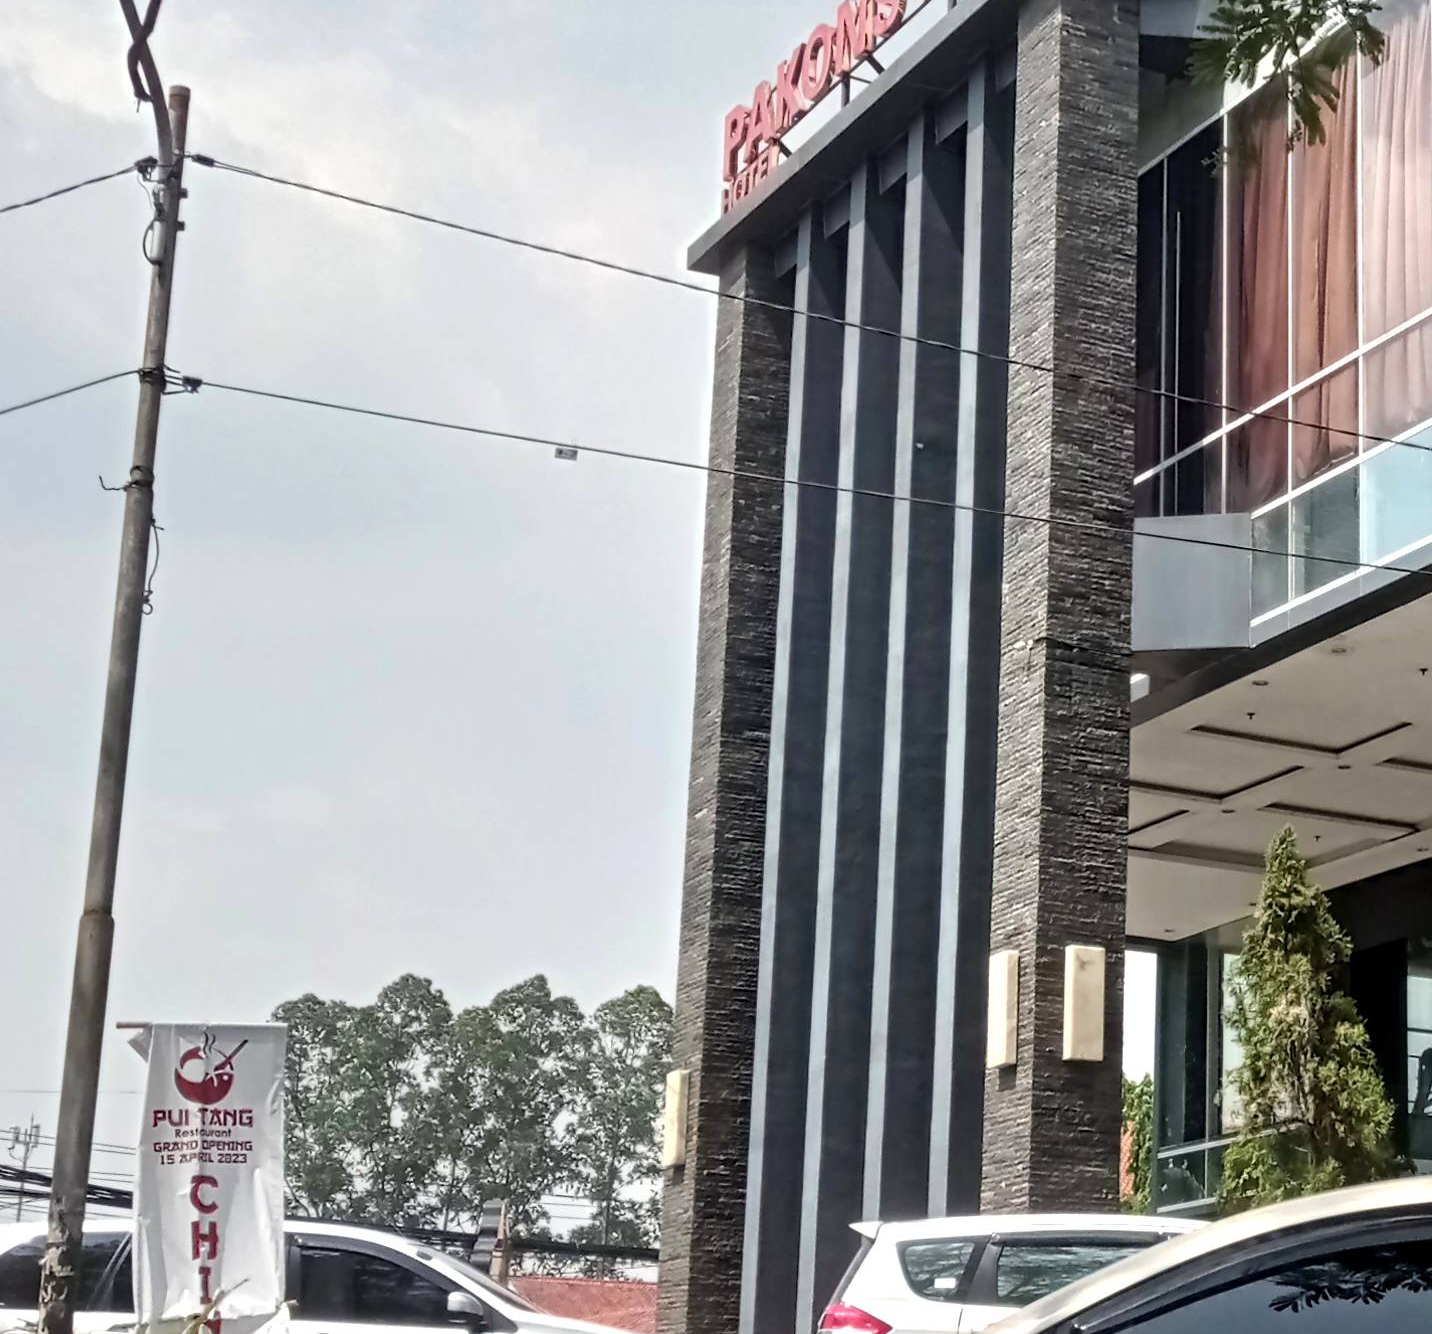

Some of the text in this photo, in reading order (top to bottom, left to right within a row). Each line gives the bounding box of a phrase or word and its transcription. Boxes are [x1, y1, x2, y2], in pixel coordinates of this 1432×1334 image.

[153, 1107, 253, 1128] PUI TANG
[175, 1128, 232, 1138] Restaurant
[153, 1140, 253, 1152] GRAND OPENING
[160, 1152, 248, 1165] 15 APRIL 2023
